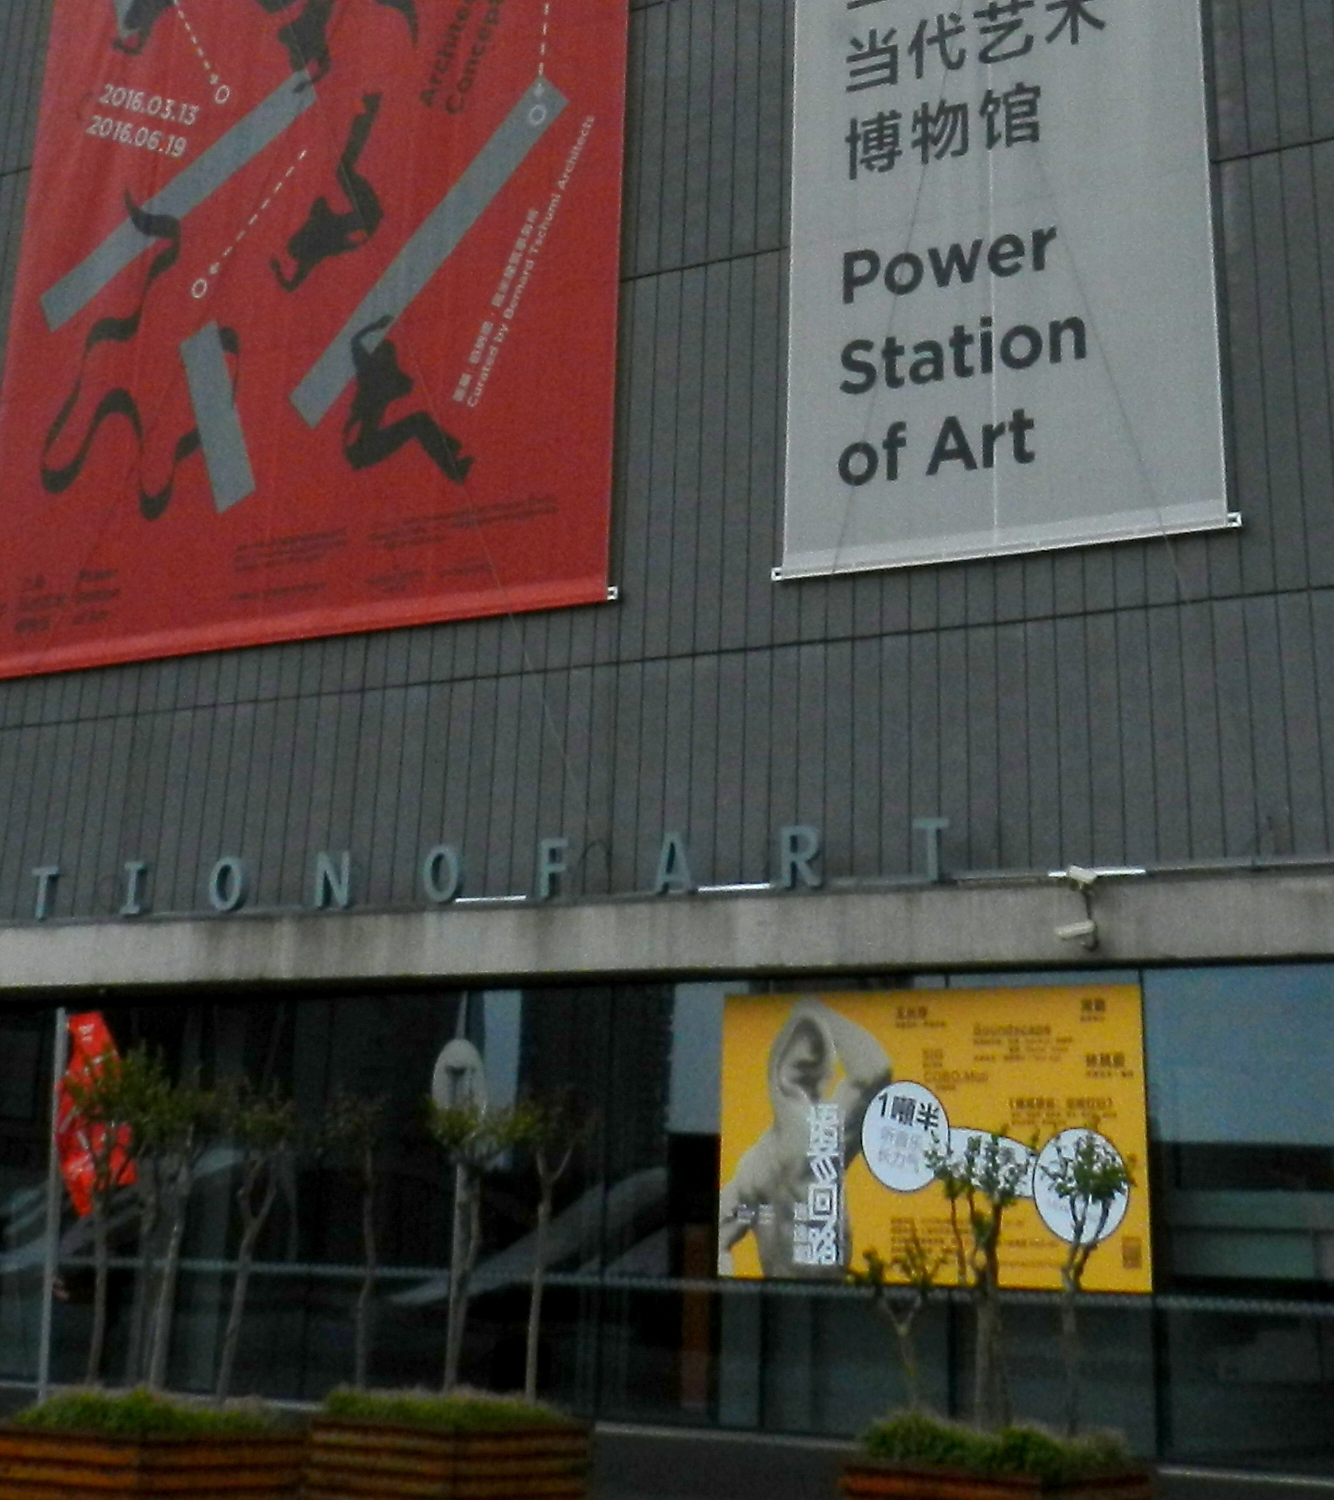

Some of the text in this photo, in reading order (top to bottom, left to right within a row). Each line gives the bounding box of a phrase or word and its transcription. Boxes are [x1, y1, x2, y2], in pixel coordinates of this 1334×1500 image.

[86, 115, 187, 157] 2016.06.19
[99, 83, 200, 126] 2016.03.13
[844, 82, 1042, 180] 博物馆
[841, 224, 1057, 304] Power
[839, 312, 1087, 397] Station
[836, 407, 1035, 487] of Art
